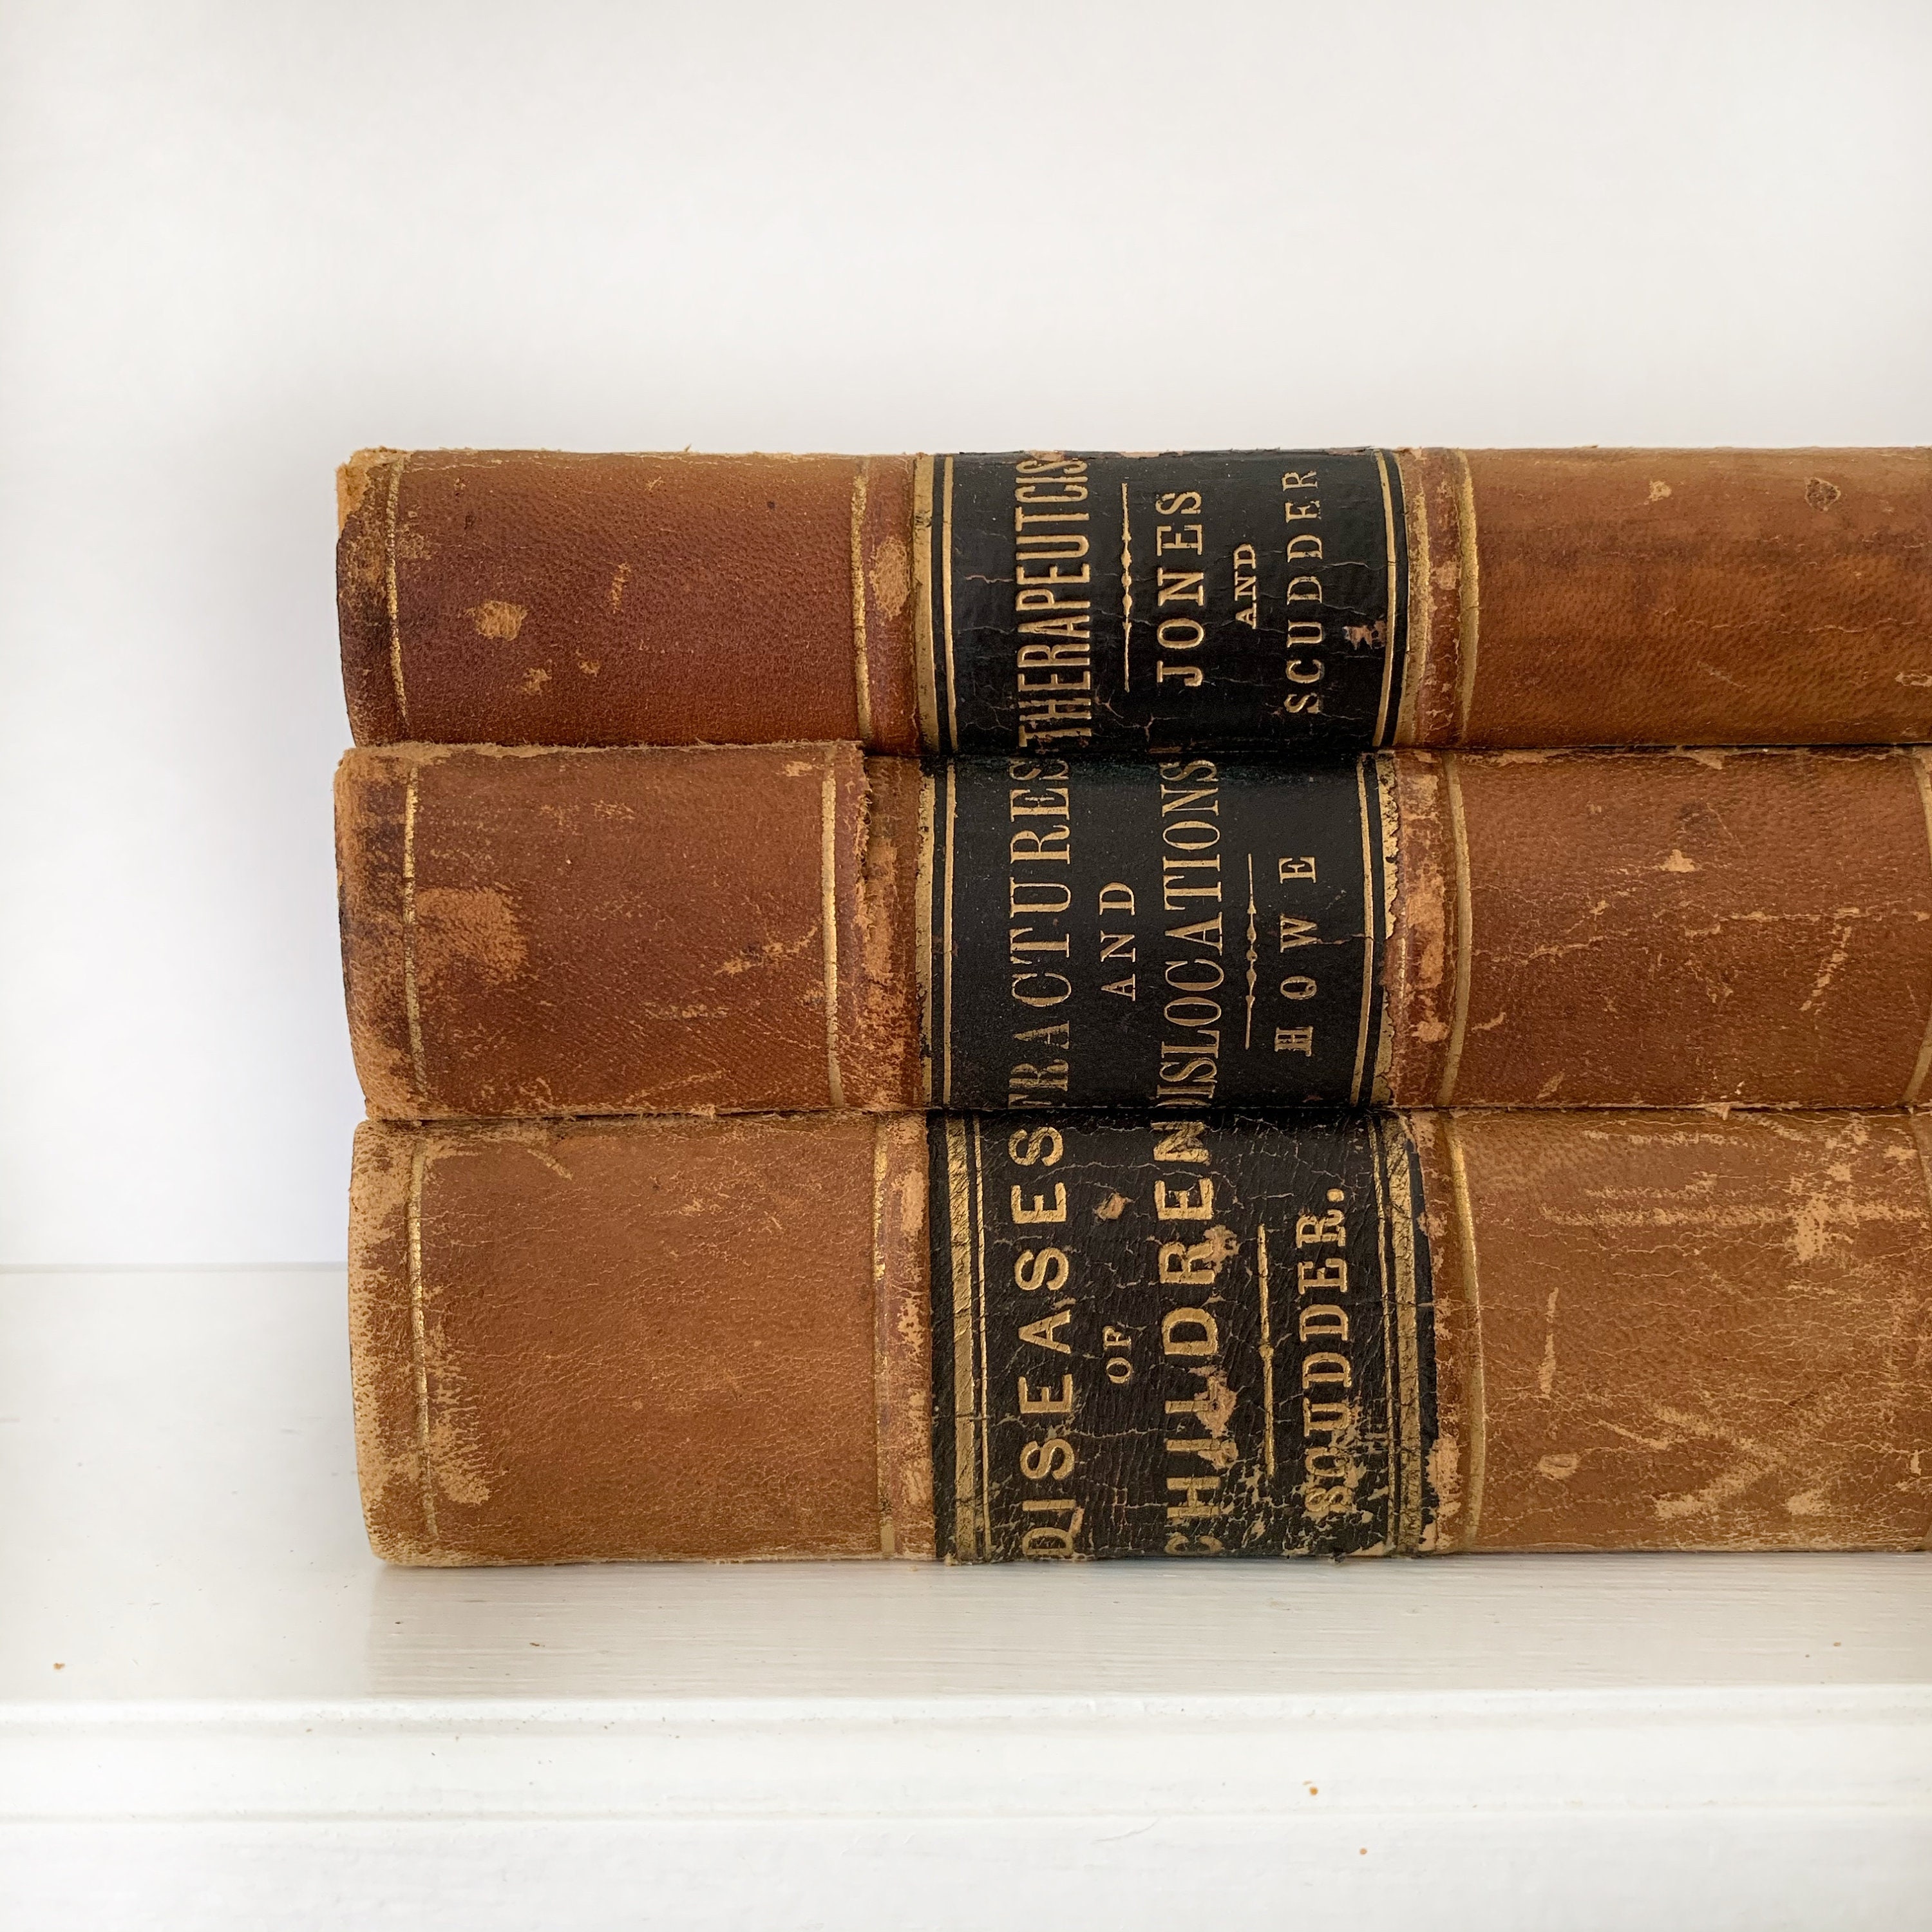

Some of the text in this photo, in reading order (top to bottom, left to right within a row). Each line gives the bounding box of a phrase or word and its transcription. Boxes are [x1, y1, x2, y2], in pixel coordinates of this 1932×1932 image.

[1014, 458, 1091, 748] THERAPEUTCIS
[1156, 491, 1204, 687] JONES
[1233, 544, 1259, 629] AND
[1281, 470, 1324, 714] SCUDDER
[1099, 882, 1136, 1002] AND
[1274, 855, 1318, 1057] HOWE
[1009, 1124, 1076, 1558] DISEASES
[1102, 1325, 1135, 1385] OF
[1296, 1187, 1355, 1515] SCUDDER.
